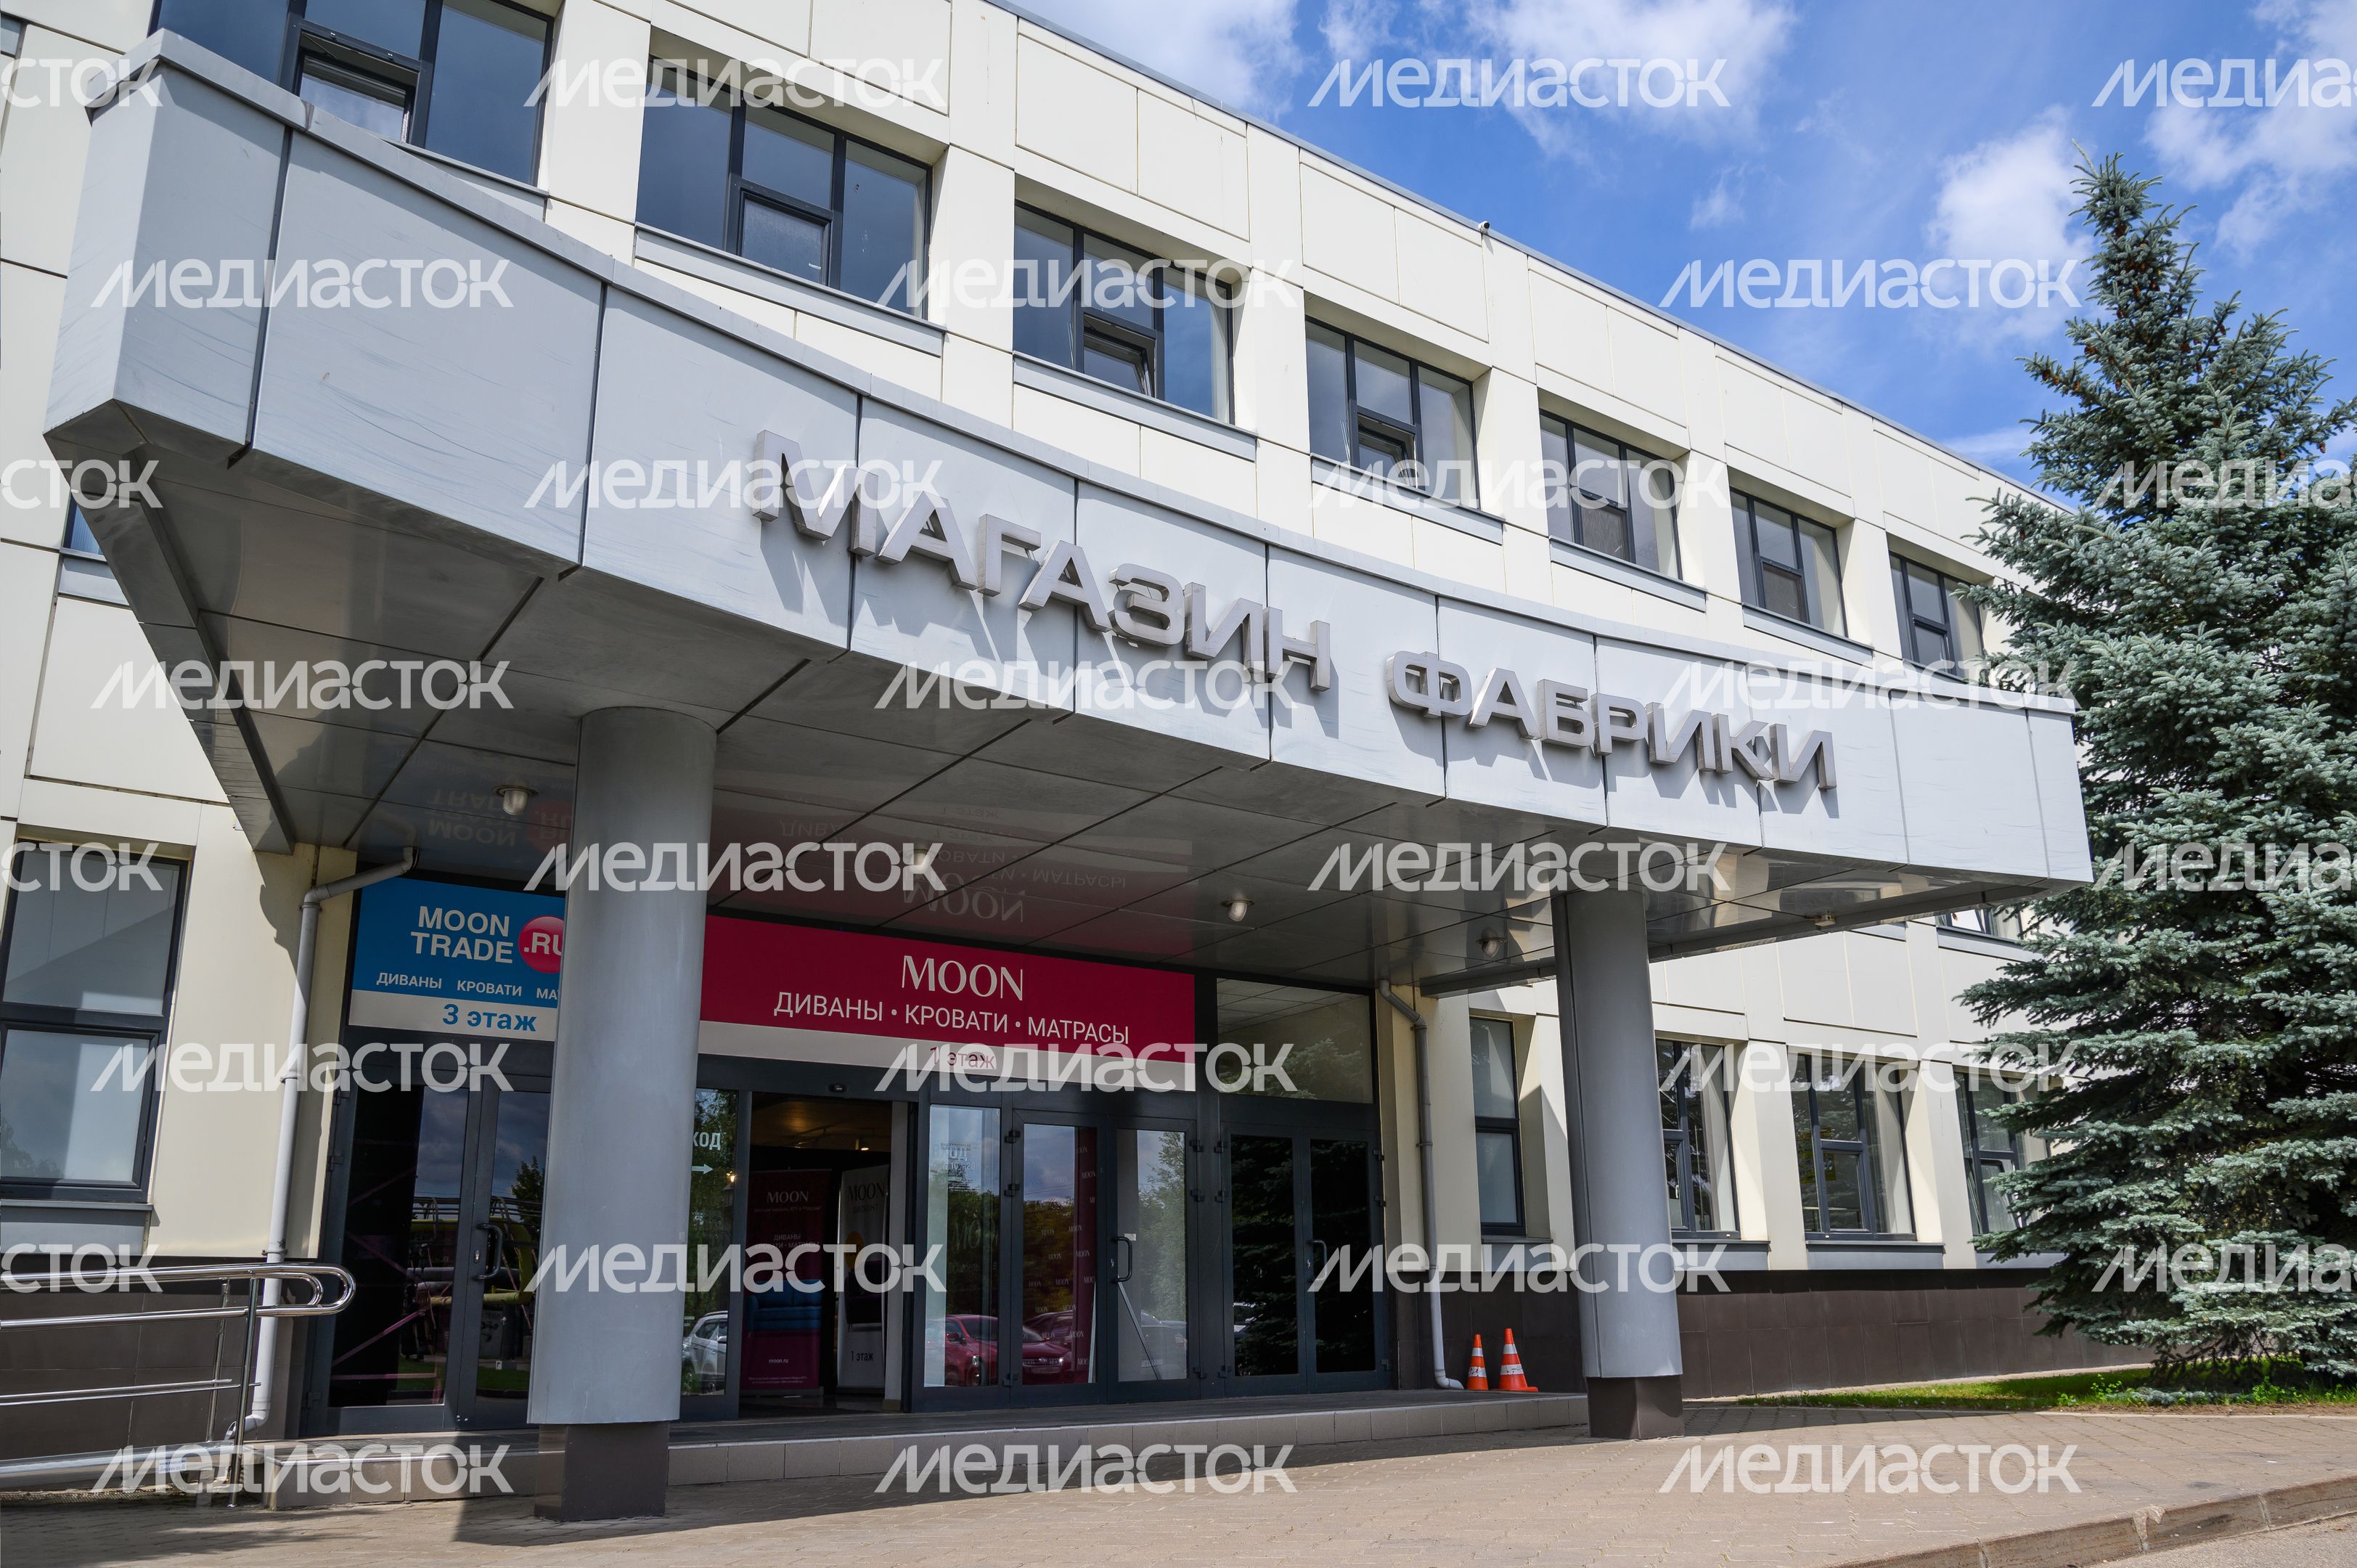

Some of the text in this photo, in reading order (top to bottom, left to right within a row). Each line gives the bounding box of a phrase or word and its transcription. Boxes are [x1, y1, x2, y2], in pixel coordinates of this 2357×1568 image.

[751, 429, 1837, 790] МАГАЗИН ФАБРИКИ
[418, 906, 510, 937] MOON
[411, 931, 514, 963] TRADE
[376, 972, 560, 1000] ДИВАНЫ КРОВАТИ МА
[902, 955, 1024, 1001] MOON
[443, 1003, 537, 1032] 3 этаж
[774, 991, 1130, 1045] ДИВАНЫ КРОВАТИ МАТРАСЫ
[930, 1046, 995, 1069] 1 этаж
[767, 1191, 809, 1203] MOON
[848, 1183, 885, 1202] MOON
[850, 1351, 875, 1362] 1 этаж
